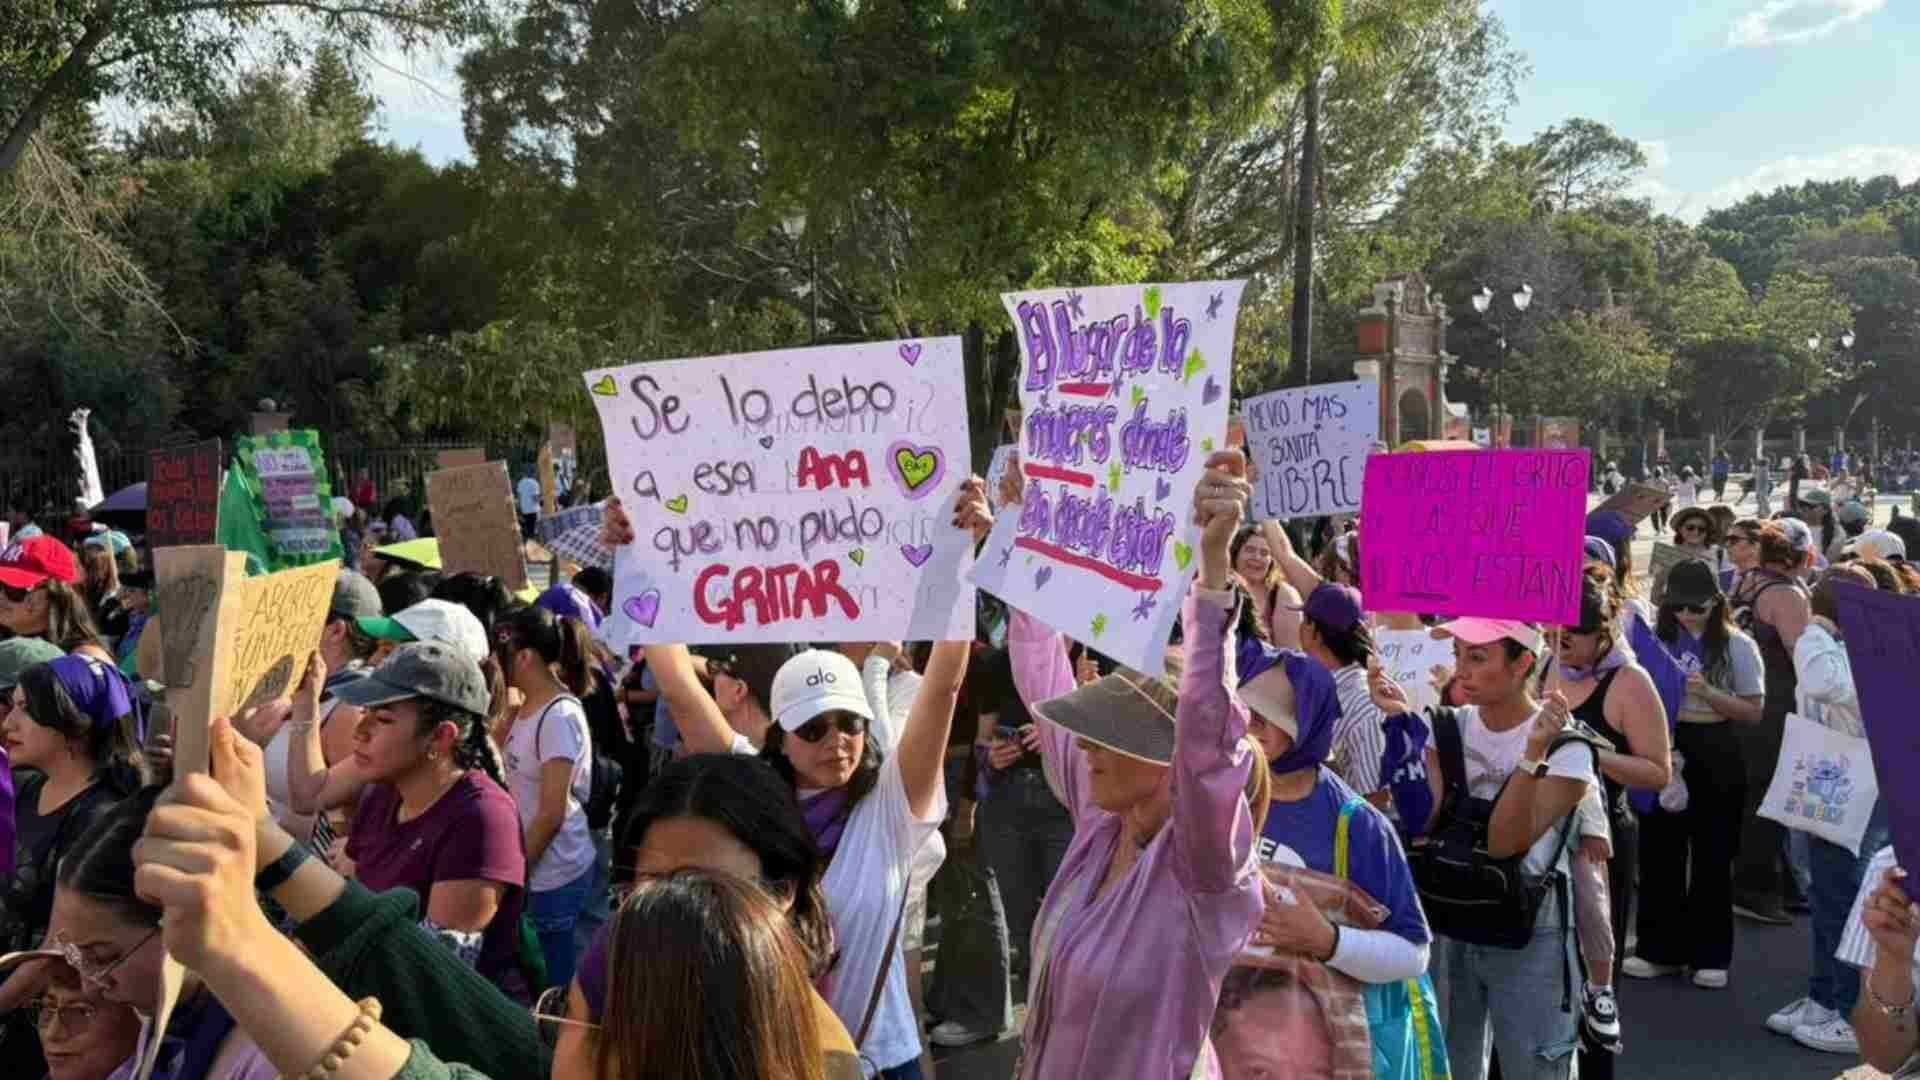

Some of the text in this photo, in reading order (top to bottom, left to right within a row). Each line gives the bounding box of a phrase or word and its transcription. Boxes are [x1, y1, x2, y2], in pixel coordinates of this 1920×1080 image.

[1052, 300, 1129, 382] lugar
[630, 375, 690, 440] Se
[720, 374, 772, 427] lo
[791, 373, 897, 424] debo
[1302, 395, 1347, 421] MAS
[633, 446, 871, 501] a esa Ana
[1513, 454, 1585, 489] GRITO
[653, 517, 721, 572] que
[735, 515, 779, 551] no
[800, 498, 884, 560] pudo
[693, 559, 860, 631] GRITAR
[806, 666, 837, 687] alo
